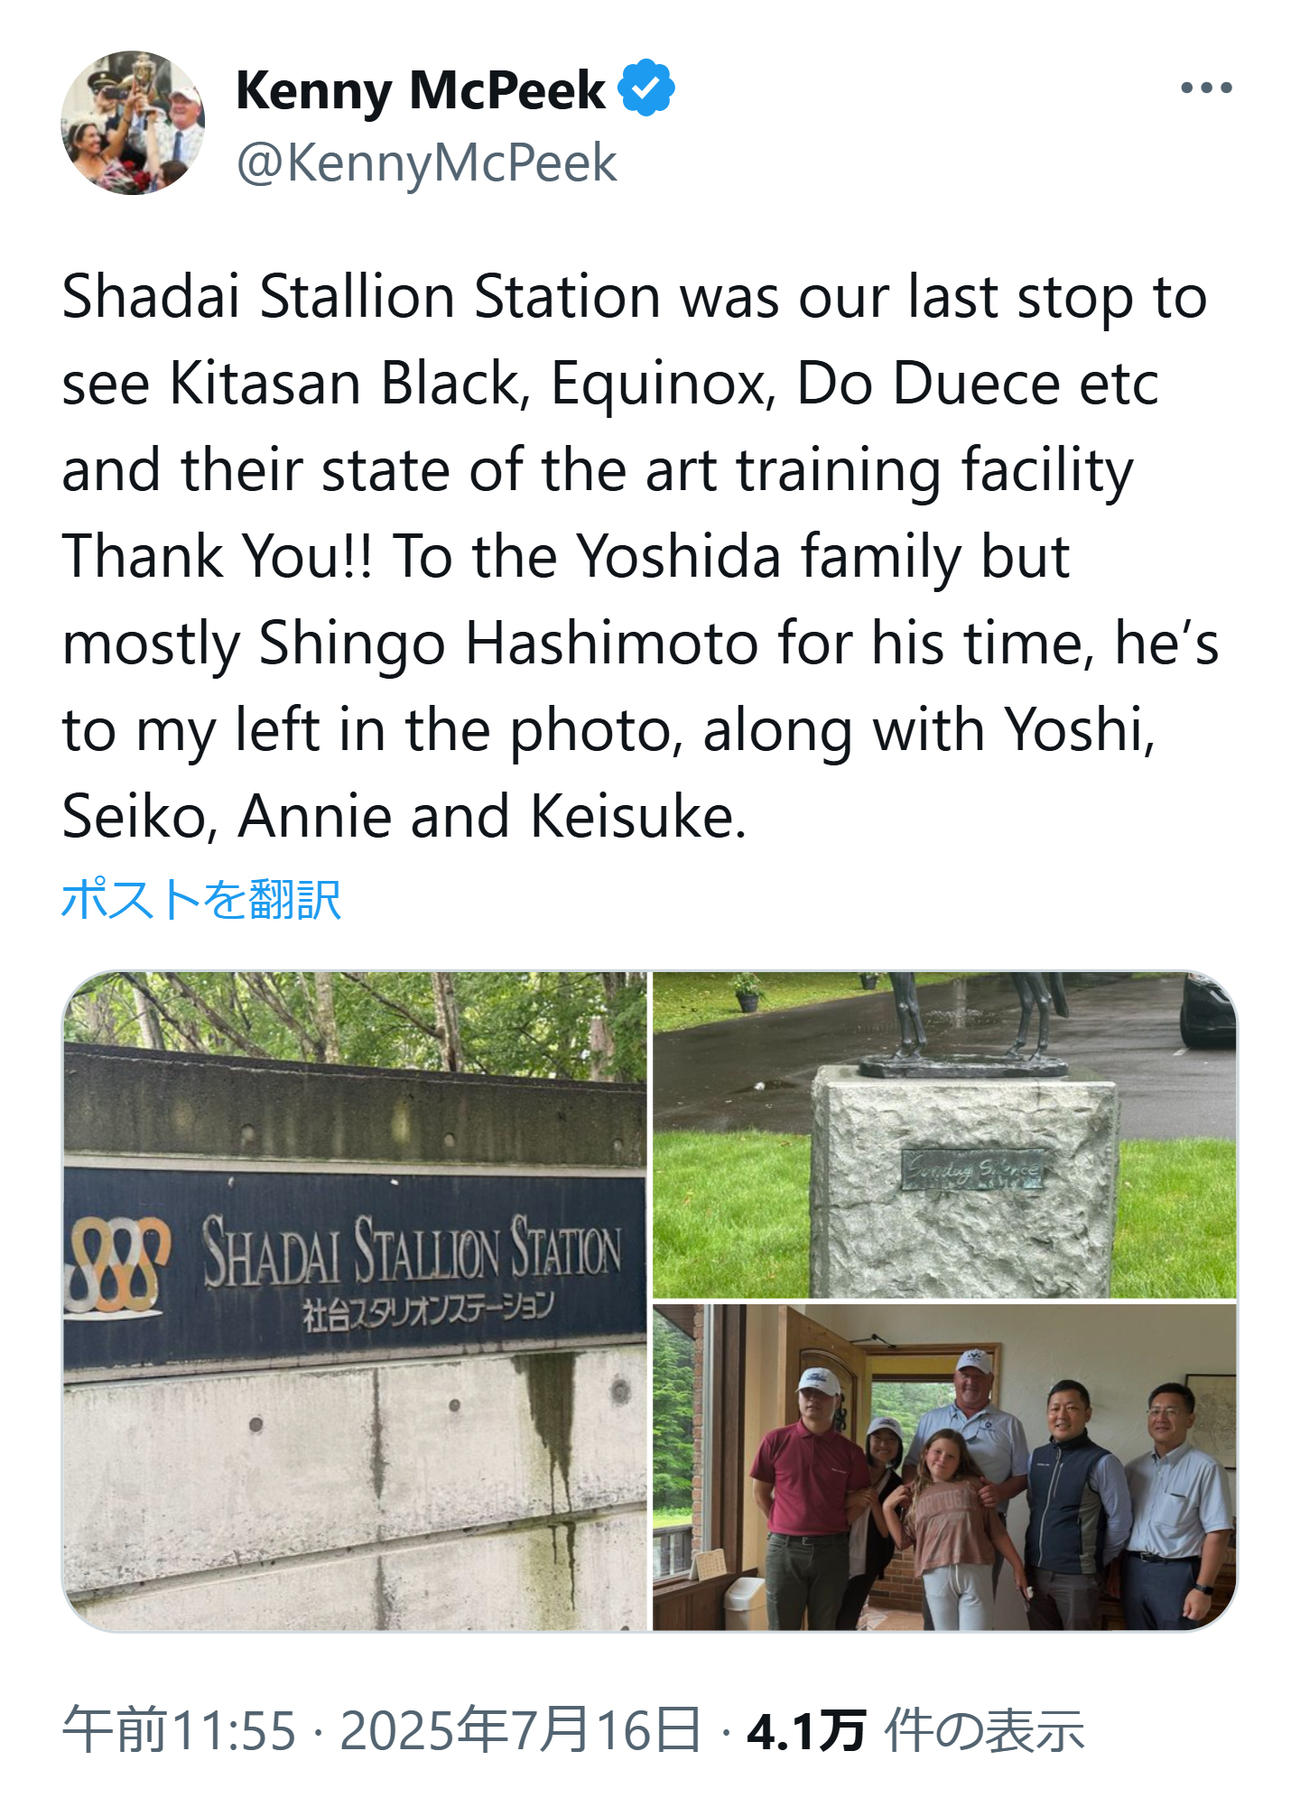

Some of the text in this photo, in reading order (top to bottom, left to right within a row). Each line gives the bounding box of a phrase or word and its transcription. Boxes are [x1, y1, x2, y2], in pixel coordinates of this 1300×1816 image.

[238, 68, 607, 122] Kenny McPeek
[238, 141, 617, 194] @KennyMcPeek
[64, 271, 1206, 332] Shadai Stallion Station was our last stop to
[64, 358, 1158, 418] see Kitasan Black, Equinox, Do Duece etc
[63, 444, 1134, 506] and their state of the art training facility
[62, 530, 1070, 592] Thank You!! To the Yoshida family but
[65, 618, 241, 679] mostly
[261, 618, 444, 679] Shingo
[469, 618, 757, 665] Hashimoto
[778, 617, 853, 665] for
[874, 618, 943, 665] his
[963, 618, 1093, 671] time,
[62, 704, 1153, 766] to my left in the photo, along with Yoshi,
[64, 791, 744, 844] Seiko, Annie and Keisuke.
[61, 875, 341, 920] ポストを翻訳
[202, 1212, 622, 1289] SHADAI STALLION STATION
[302, 1290, 555, 1333] 社台スタリオンステーション
[63, 1704, 1084, 1753] 午前11:55 2025年7月16日 4.1万 件の表示
